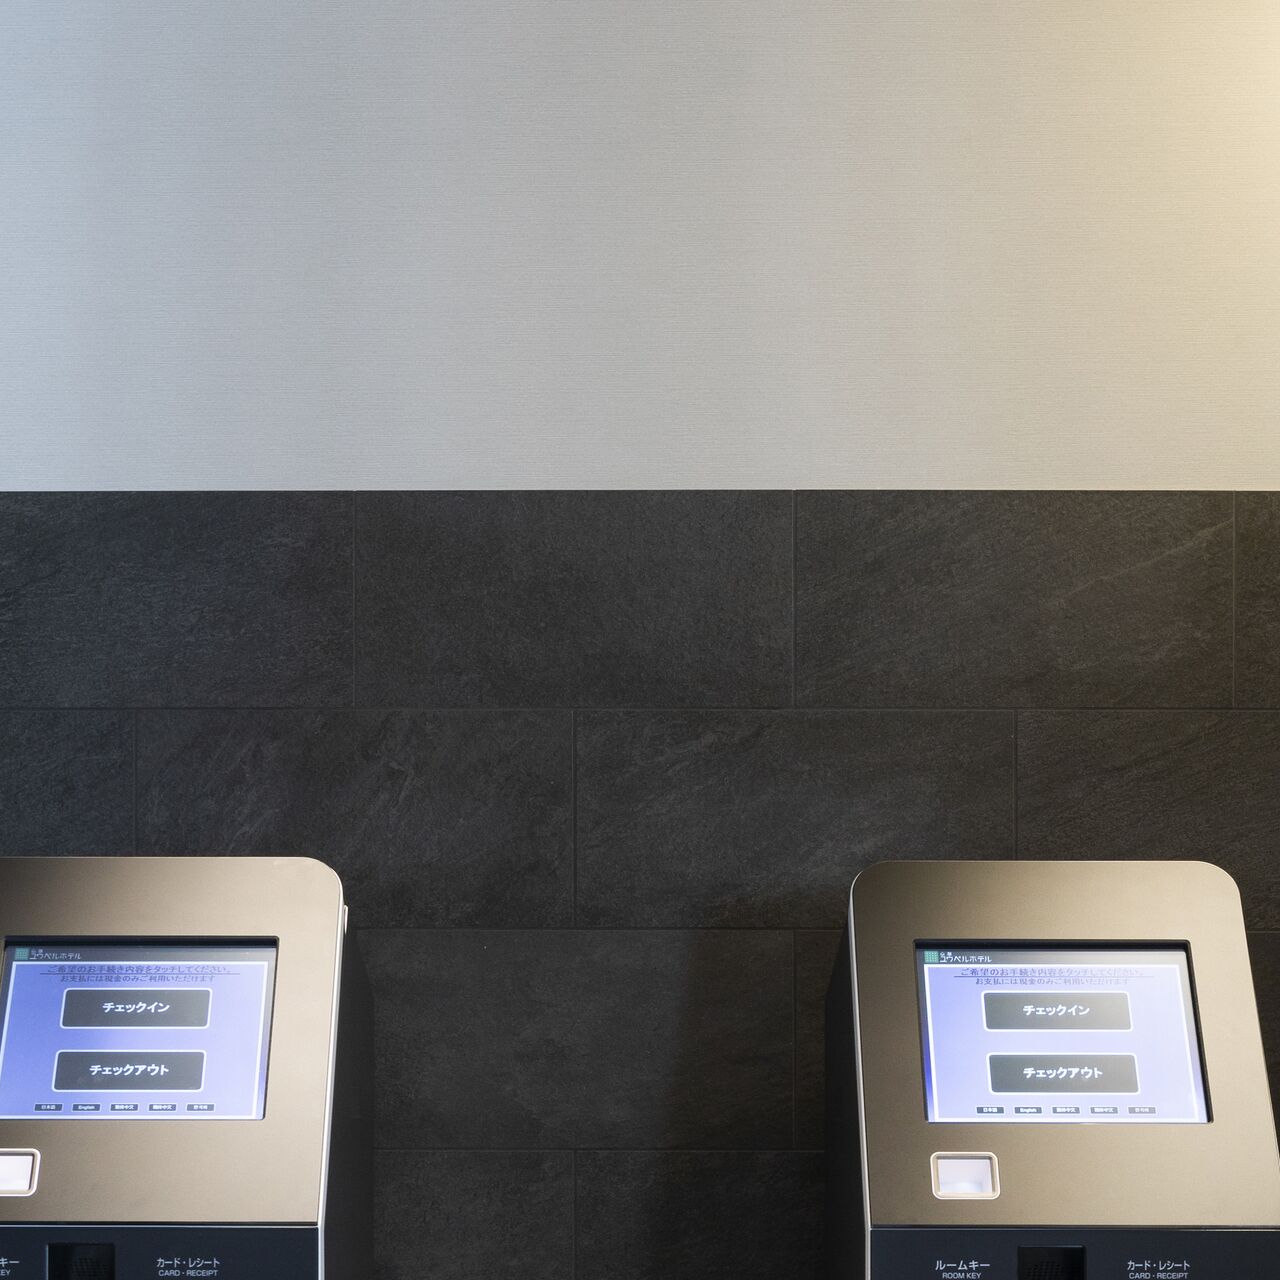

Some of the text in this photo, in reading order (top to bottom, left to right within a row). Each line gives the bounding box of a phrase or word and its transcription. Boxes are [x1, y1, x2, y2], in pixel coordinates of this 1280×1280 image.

[102, 1001, 171, 1014] チェックイン
[1022, 1004, 1091, 1016] チェックイン
[89, 1063, 170, 1076] チェックアウト
[1023, 1066, 1104, 1079] チェックアウト
[156, 1257, 220, 1268] カード・レシート
[935, 1259, 991, 1271] ルームキー
[1127, 1259, 1191, 1271] カード・レシート
[942, 1272, 982, 1280] ROOM KEY
